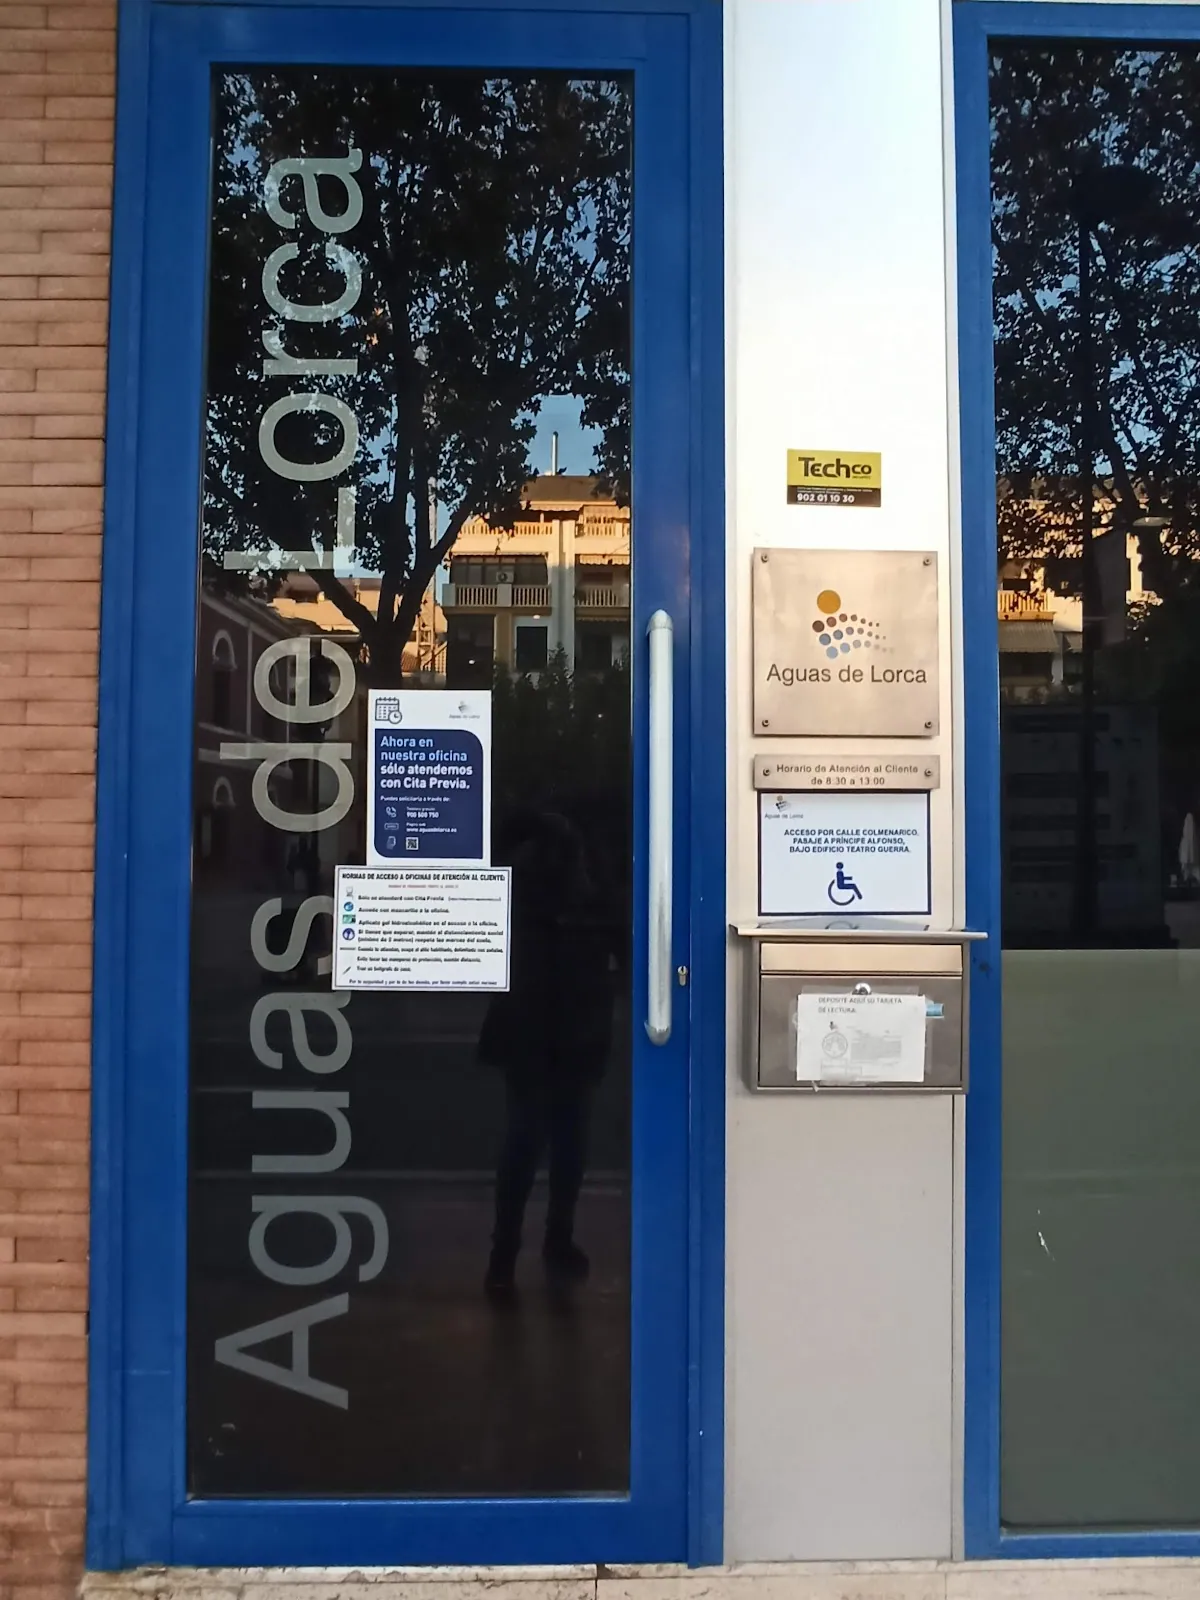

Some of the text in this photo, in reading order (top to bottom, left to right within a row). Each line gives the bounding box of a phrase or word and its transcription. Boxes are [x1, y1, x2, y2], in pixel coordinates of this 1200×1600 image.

[797, 493, 855, 503] 902 01 10 30
[766, 664, 927, 686] Aguas de Lorca
[380, 736, 433, 747] Ahora en
[380, 750, 467, 761] nuestra oficina
[380, 762, 473, 775] sólo atendemos
[776, 764, 918, 774] Horario de Atención al Cliente
[215, 148, 389, 1411] Aguas de Lorca
[380, 780, 401, 788] con
[403, 777, 426, 788] Cita
[811, 777, 822, 785] de
[826, 776, 846, 785] 830
[860, 777, 885, 786] 1300
